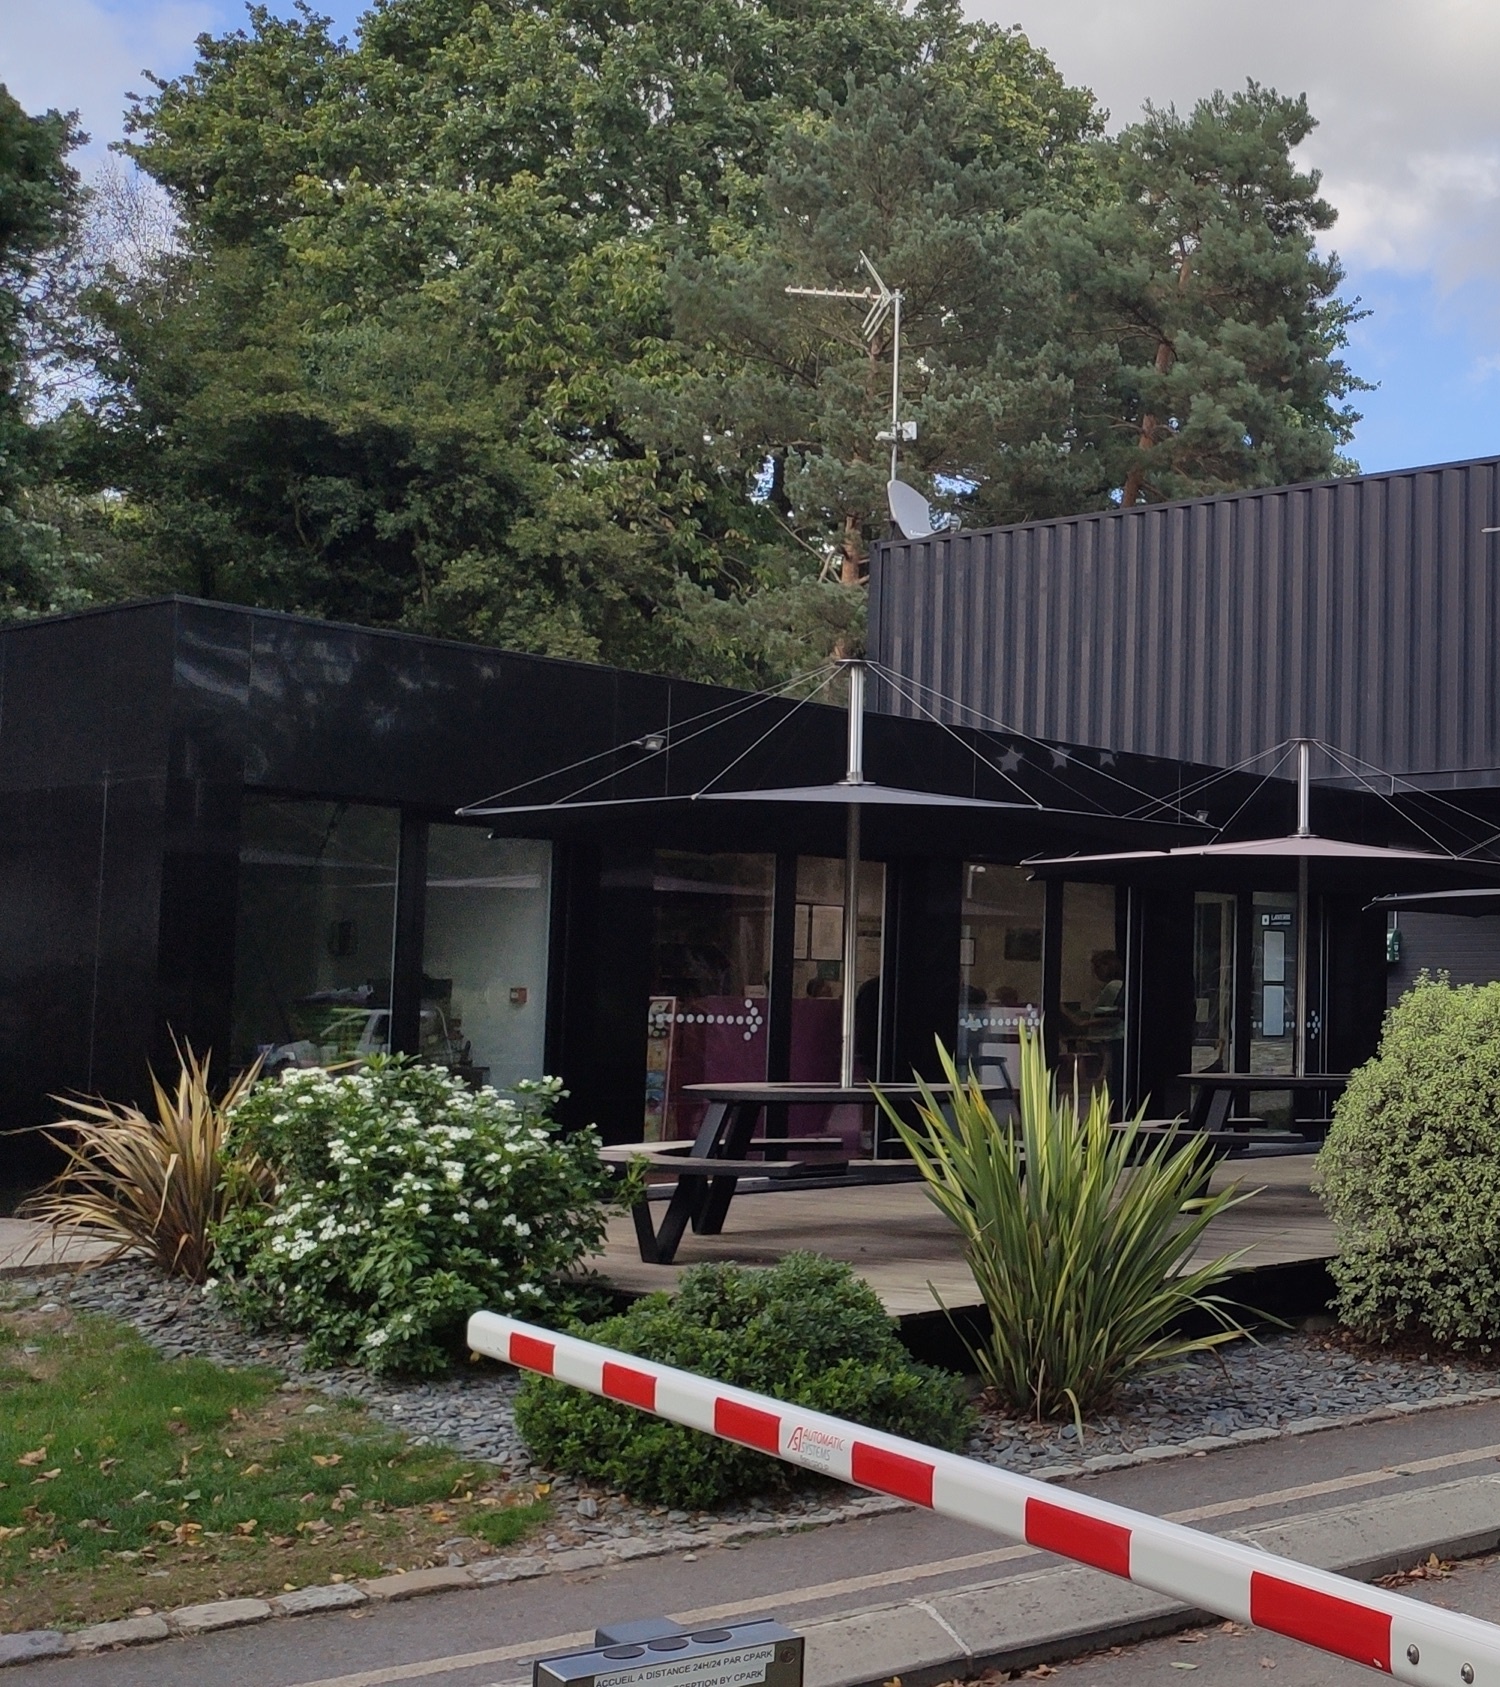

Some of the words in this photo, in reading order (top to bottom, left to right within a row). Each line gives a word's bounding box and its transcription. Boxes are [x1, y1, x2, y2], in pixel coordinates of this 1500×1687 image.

[803, 1428, 846, 1451] AUTOMATIC
[801, 1441, 831, 1461] SYSTEMS
[595, 1675, 635, 1687] ACCUEIL
[646, 1664, 691, 1680] DISTANCE
[692, 1658, 722, 1672] 24H/24
[723, 1655, 742, 1665] PAR
[743, 1649, 773, 1662] CPARK
[719, 1675, 733, 1685] BY
[733, 1669, 764, 1682] CPARK
